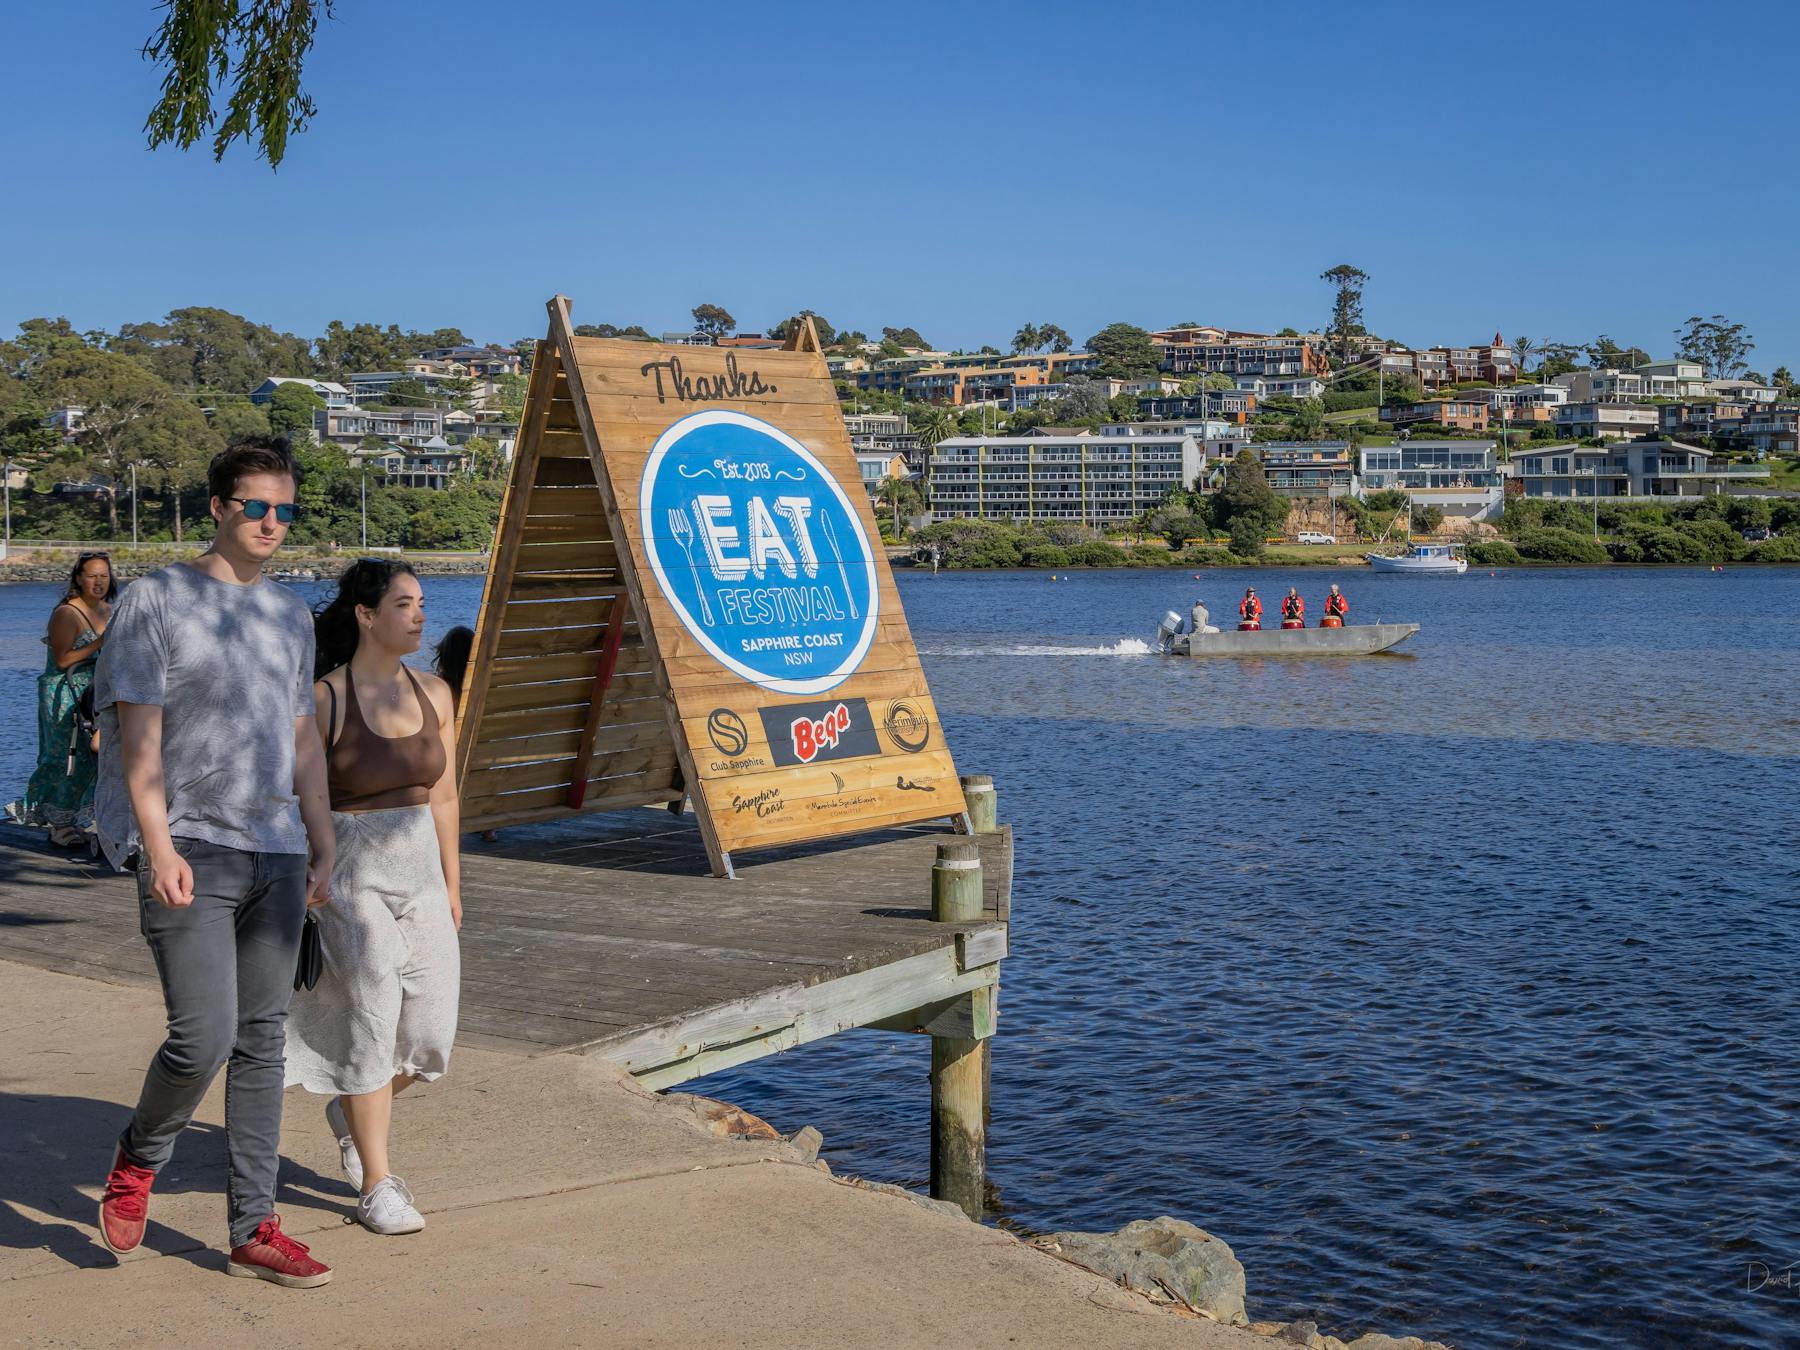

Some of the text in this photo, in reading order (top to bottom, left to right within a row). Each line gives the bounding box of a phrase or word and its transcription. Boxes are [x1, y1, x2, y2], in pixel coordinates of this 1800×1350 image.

[641, 351, 777, 404] Thanks.
[744, 462, 772, 482] 2013
[691, 495, 819, 582] EAT
[717, 586, 846, 625] FESTIVAL
[741, 633, 843, 652] SAPPHIRE COAST
[784, 652, 813, 666] NSW
[791, 703, 851, 763] Bega
[710, 757, 765, 772] Club Sapphire
[732, 788, 780, 814] Sapphire
[756, 800, 784, 818] Coast
